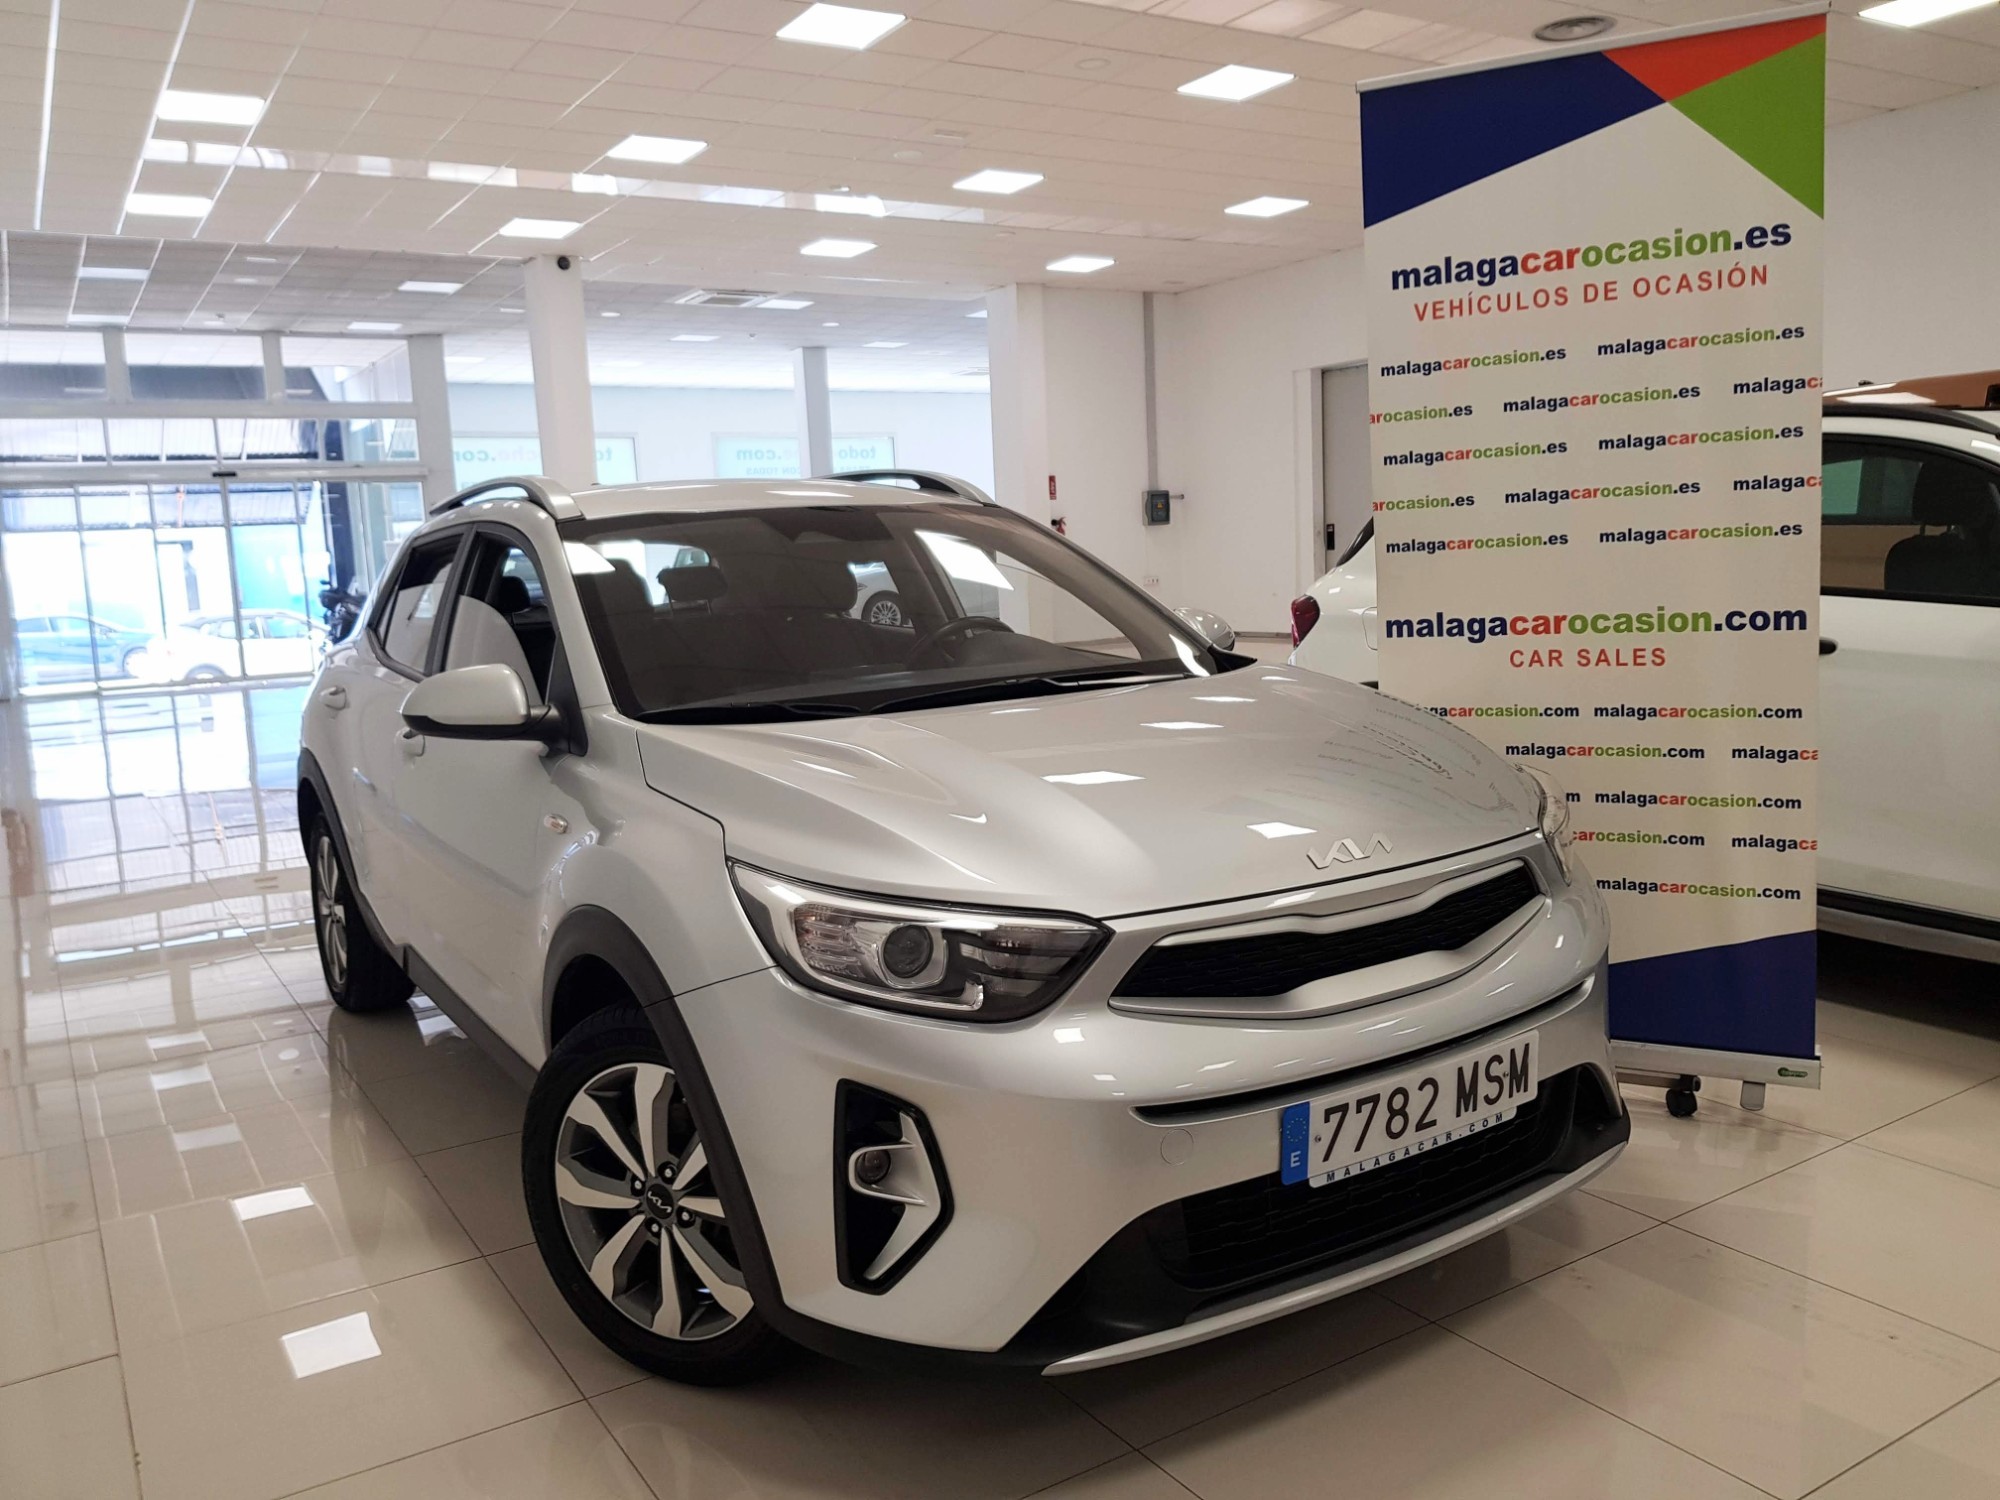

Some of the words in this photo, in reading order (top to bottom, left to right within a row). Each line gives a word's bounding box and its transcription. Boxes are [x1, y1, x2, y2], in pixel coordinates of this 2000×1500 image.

[1392, 223, 1792, 291] malagacarocasion.es
[1414, 284, 1569, 322] VEHÍCULOS
[1583, 281, 1619, 303] DE
[1632, 262, 1769, 298] OCASIÓN
[1598, 327, 1804, 356] malagacarocasion.es
[1381, 347, 1567, 377] malagacarocasion.es
[1503, 385, 1701, 413] malagacarocasion.es
[1599, 426, 1804, 451] malagacarocasion.es
[1384, 442, 1567, 466] malagacarocasion.es
[1505, 482, 1700, 504] malagacarocasion.es
[1386, 533, 1568, 554] malagacarocasion.es
[1600, 523, 1803, 545] malagacarocasion.es
[1385, 606, 1808, 643] malagacarocasion.com
[1509, 650, 1564, 668] CAR
[1577, 648, 1666, 668] SALES
[1594, 704, 1802, 721] malagacarocasion.com
[1506, 743, 1704, 759] malagacarocasion.com
[1595, 791, 1801, 809] malagacarocasion.com
[1596, 878, 1800, 900] malagacarocasion.com
[1322, 1077, 1440, 1163] 7782
[1455, 1043, 1530, 1118] MSM
[1290, 1151, 1301, 1167] E
